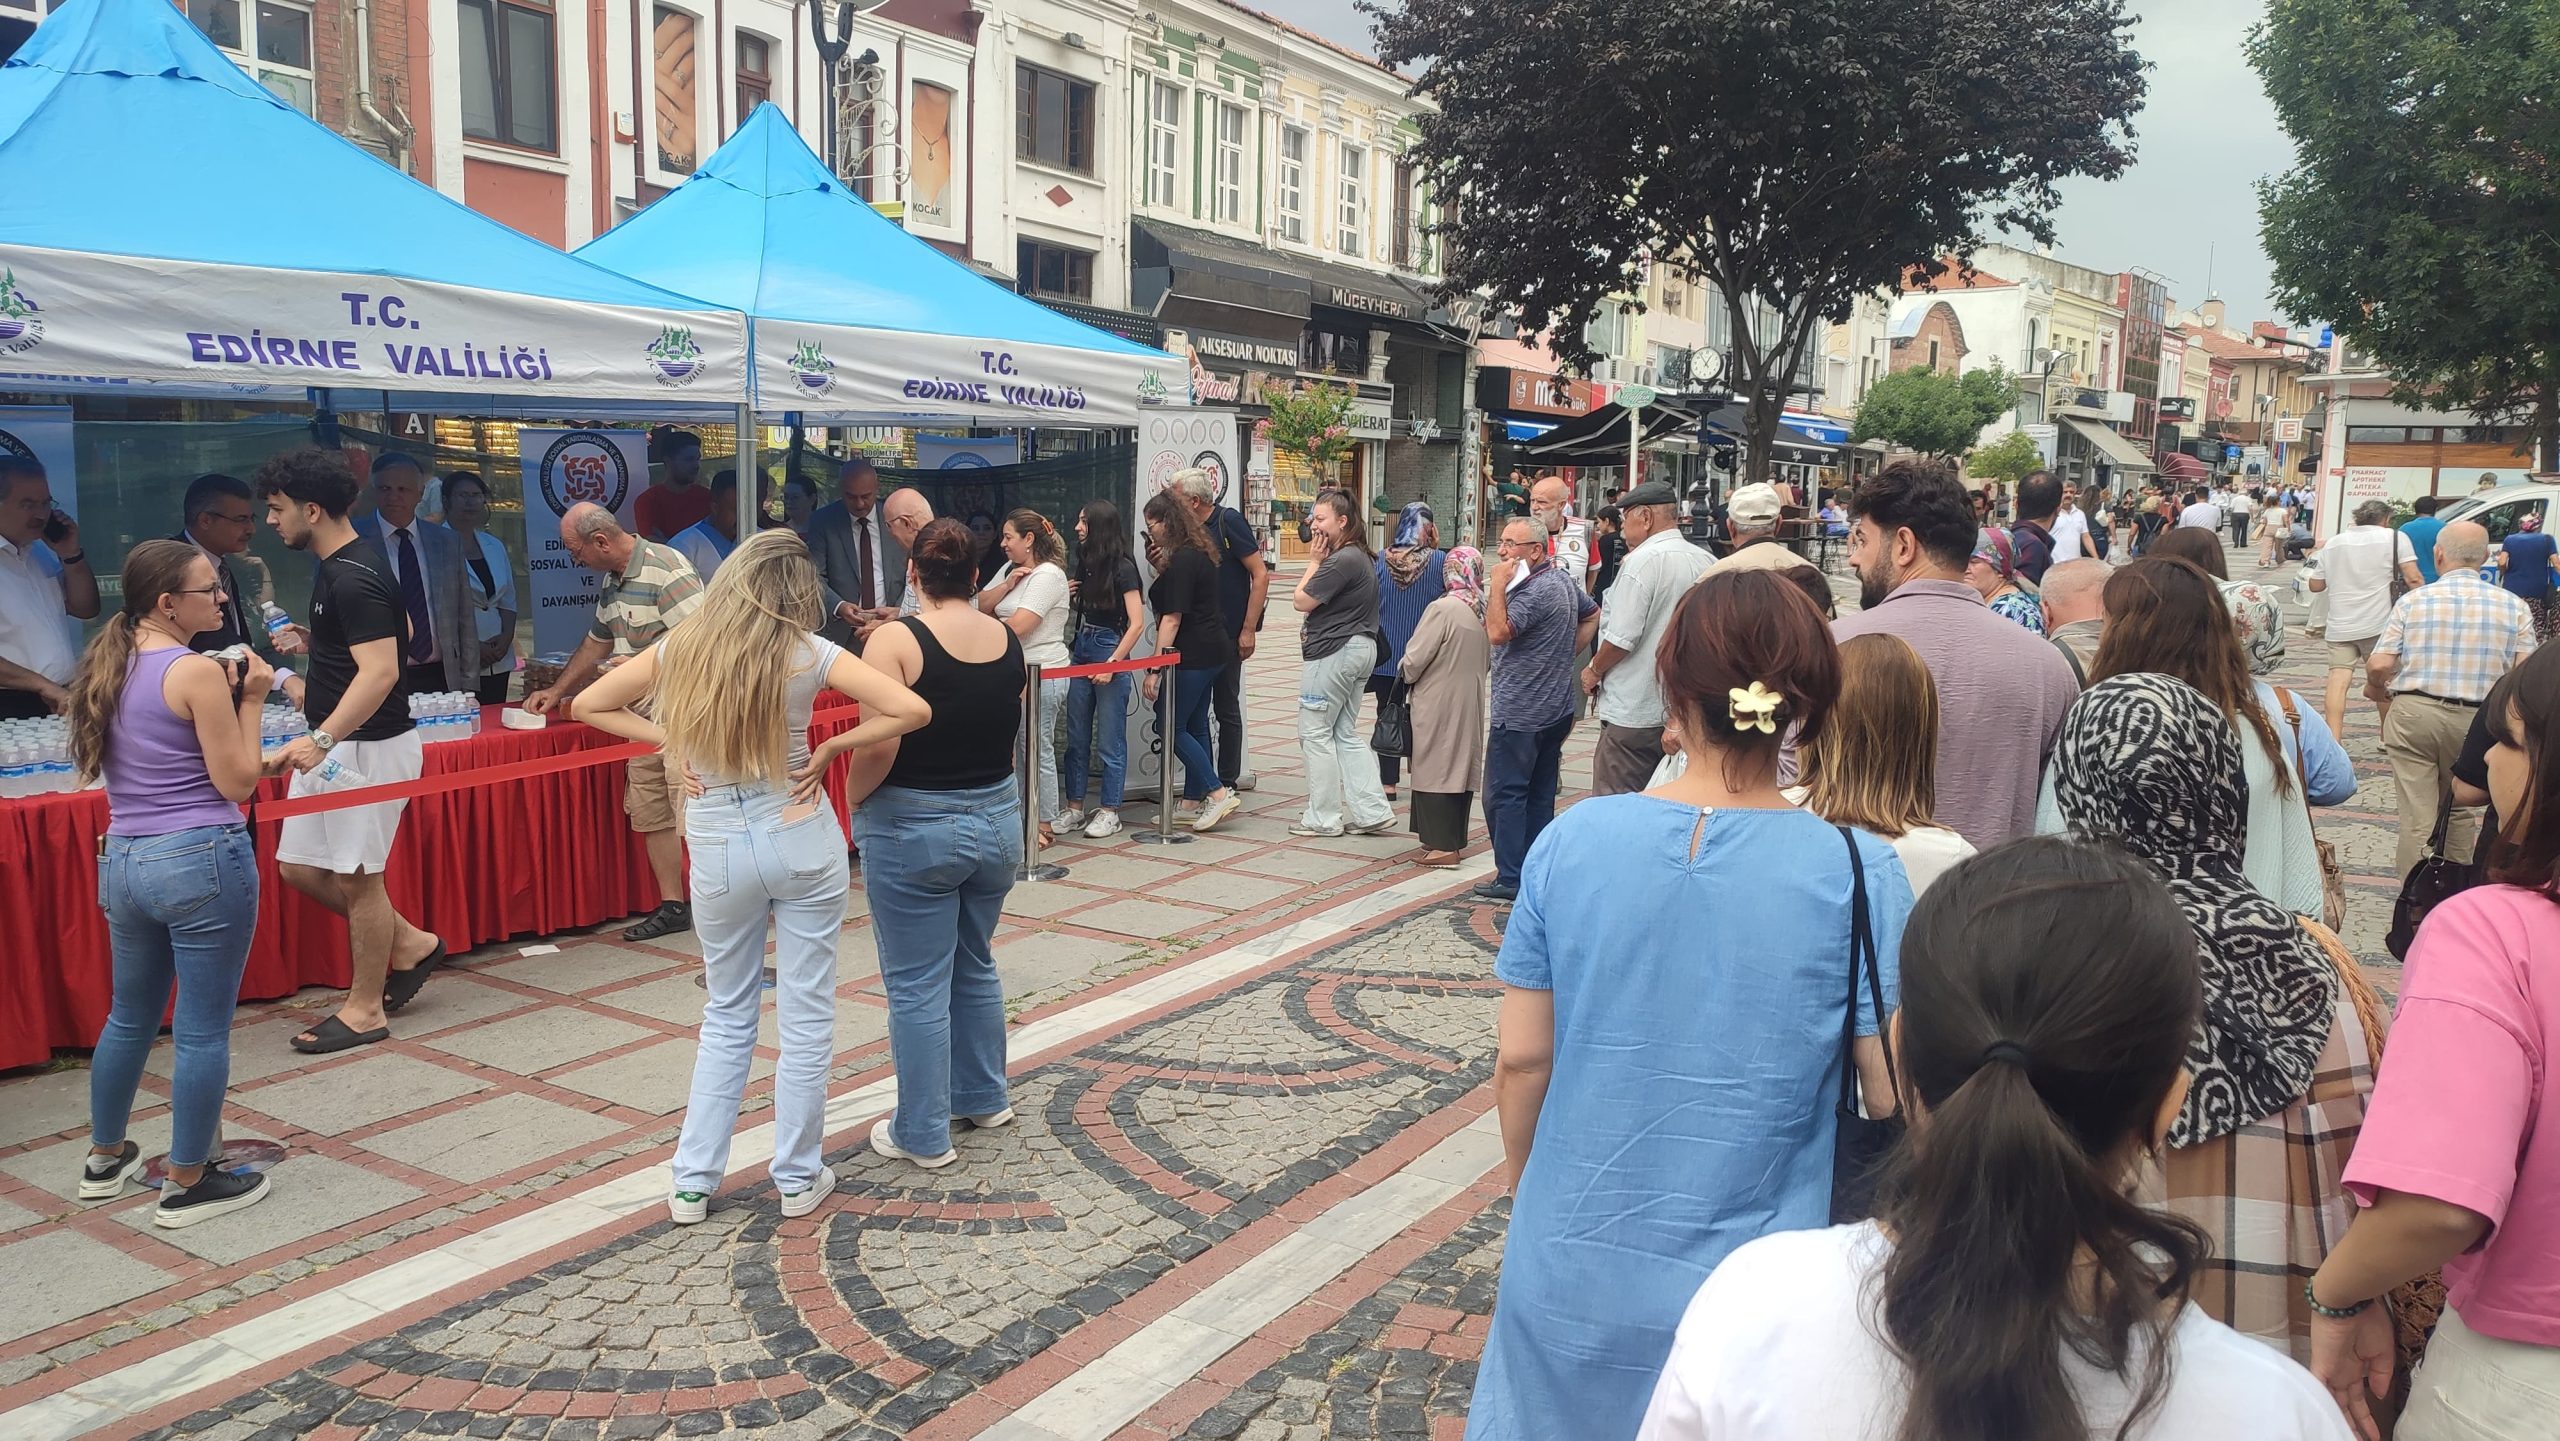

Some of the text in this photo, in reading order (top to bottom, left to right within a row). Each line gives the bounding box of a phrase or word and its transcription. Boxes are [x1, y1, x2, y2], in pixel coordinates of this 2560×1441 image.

[341, 292, 420, 330] T.C.
[1331, 286, 1410, 319] MÜCEVHERAT
[186, 328, 553, 381] EDİRNE VALİLİĞİ
[980, 351, 1019, 376] T.C.
[1199, 336, 1297, 367] AKSESUAR NOKTASI
[903, 376, 1086, 410] EDİRNE VALİLİĞİ
[530, 559, 568, 571] SOSYAL
[580, 576, 594, 586] VE
[542, 593, 600, 608] DAYANIŞMA
